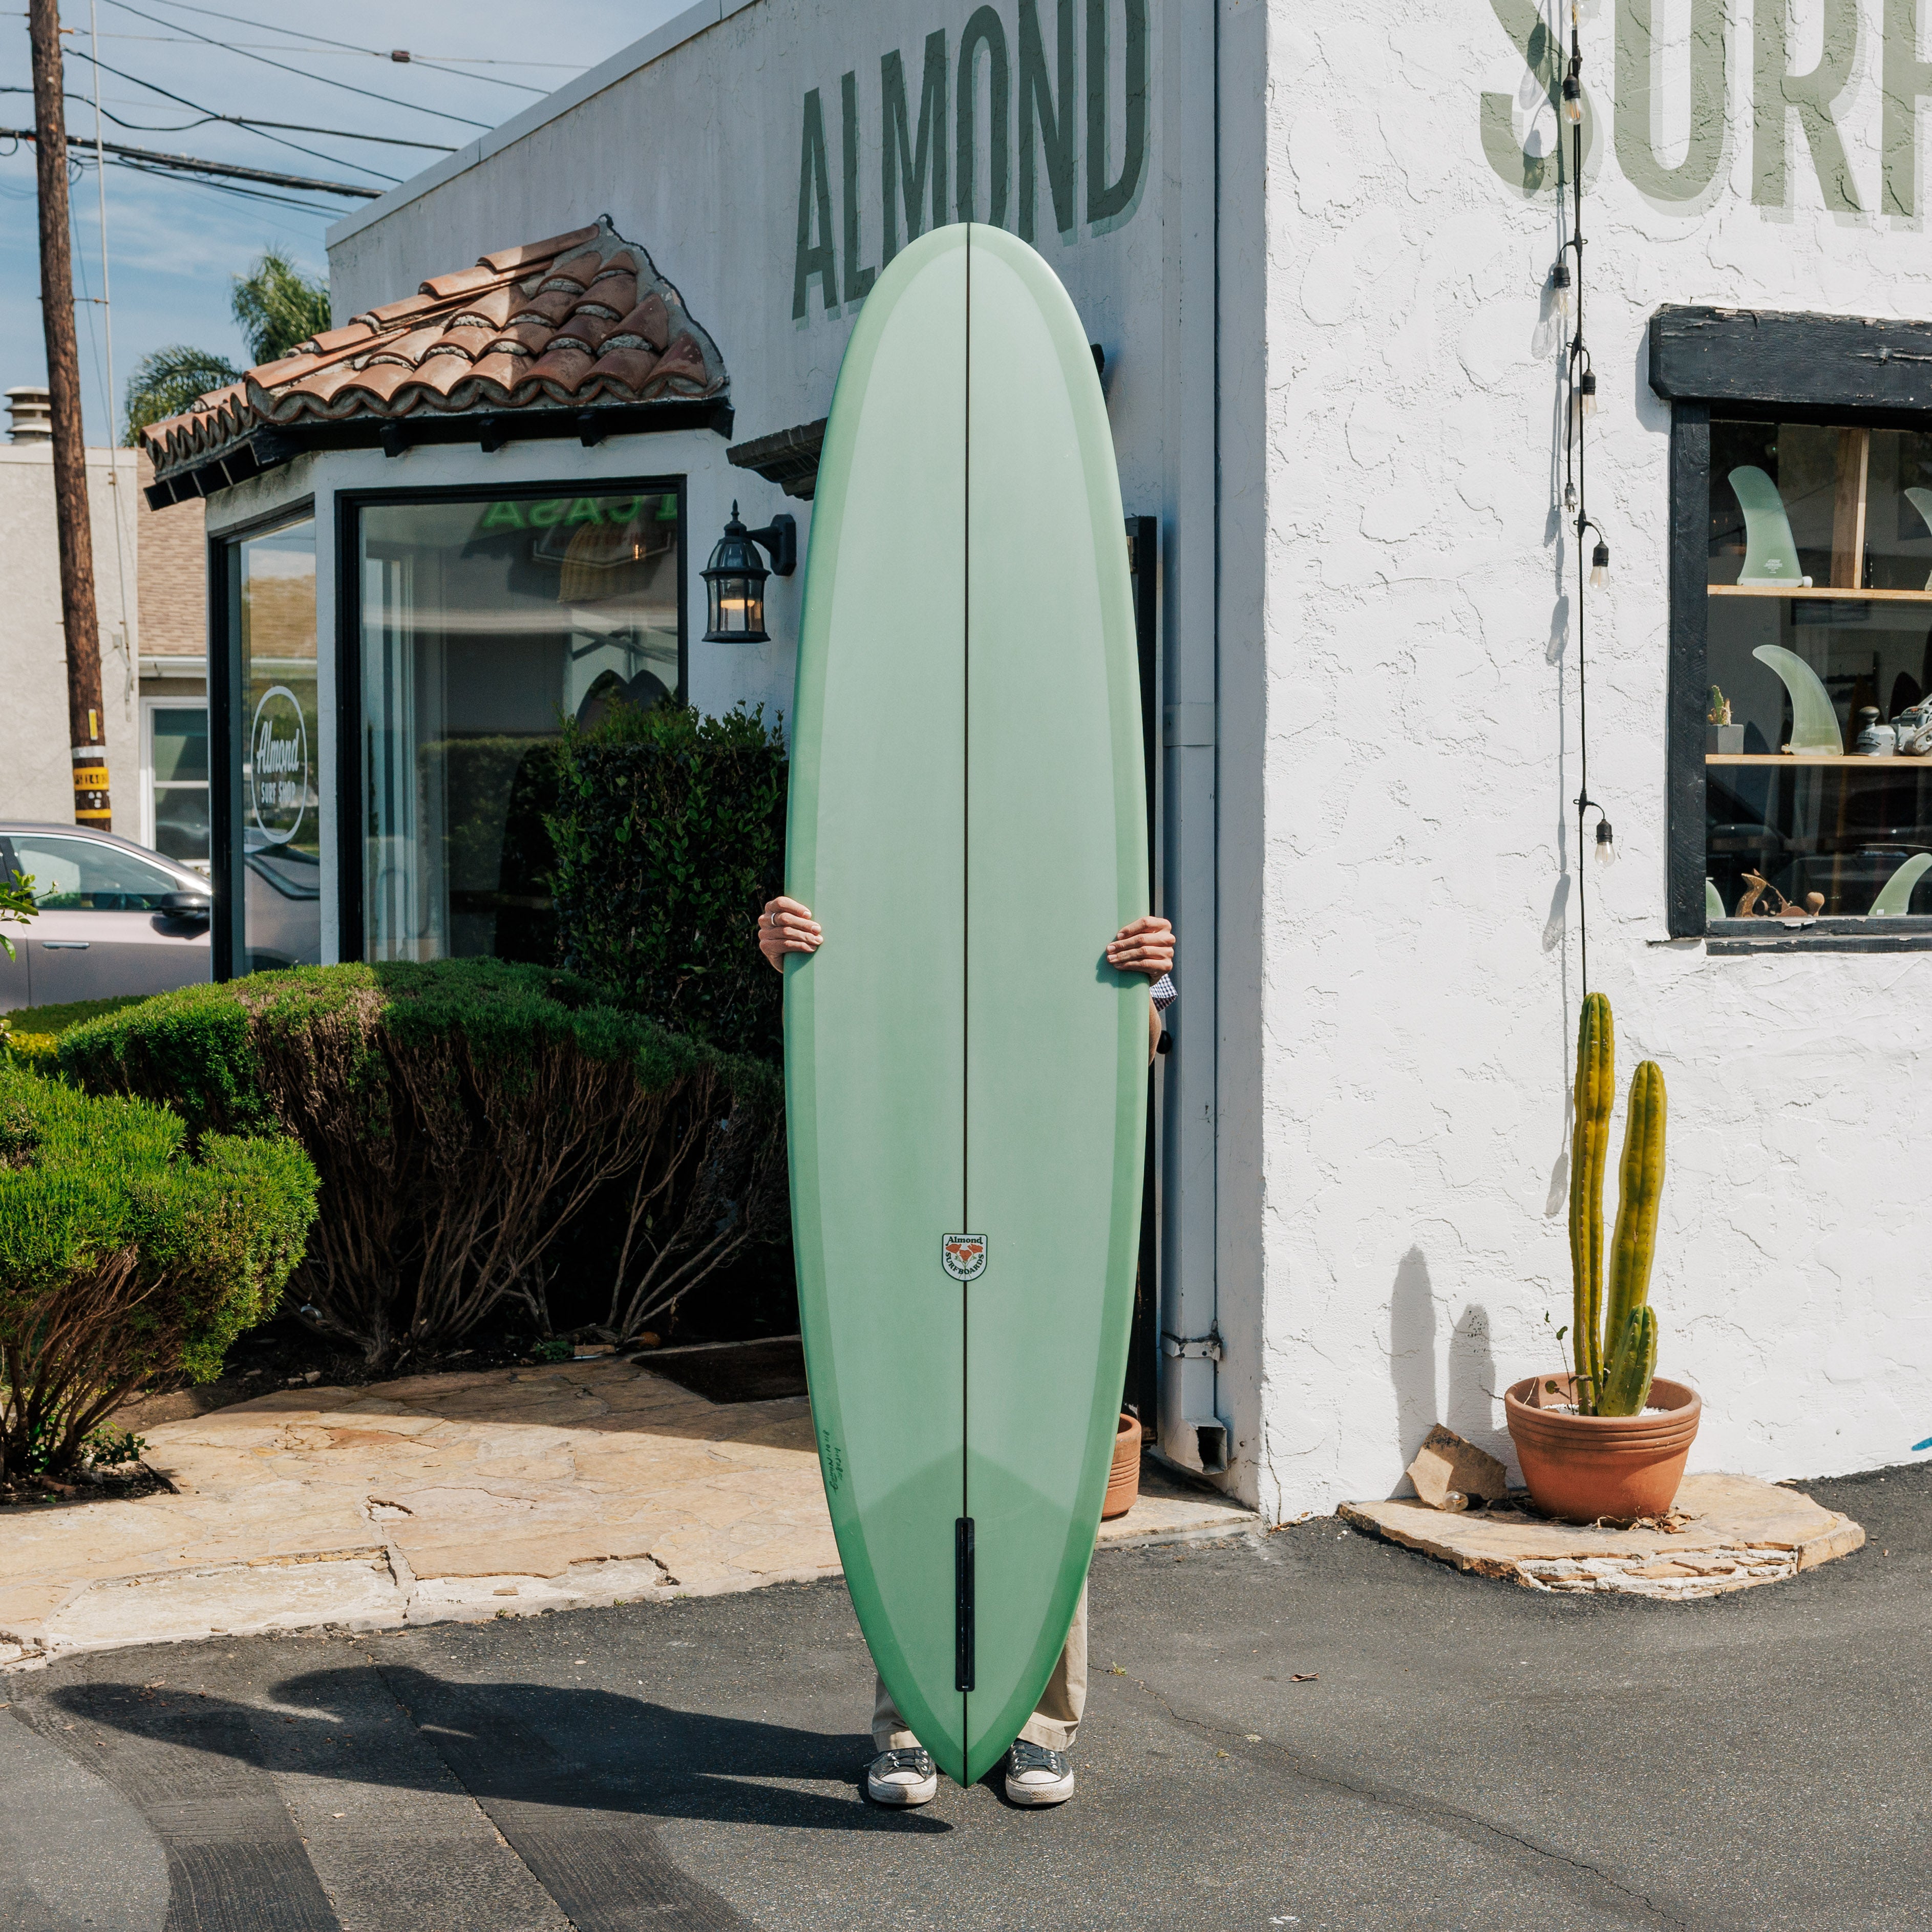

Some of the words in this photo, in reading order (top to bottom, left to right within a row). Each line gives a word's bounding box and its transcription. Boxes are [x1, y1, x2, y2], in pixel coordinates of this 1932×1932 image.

[792, 0, 1148, 325] ALMOND
[257, 720, 300, 774] Almond
[261, 781, 277, 804] SURF
[278, 780, 296, 804] SHOP
[945, 1236, 984, 1246] Almond
[945, 1252, 984, 1275] SURFBOARDS
